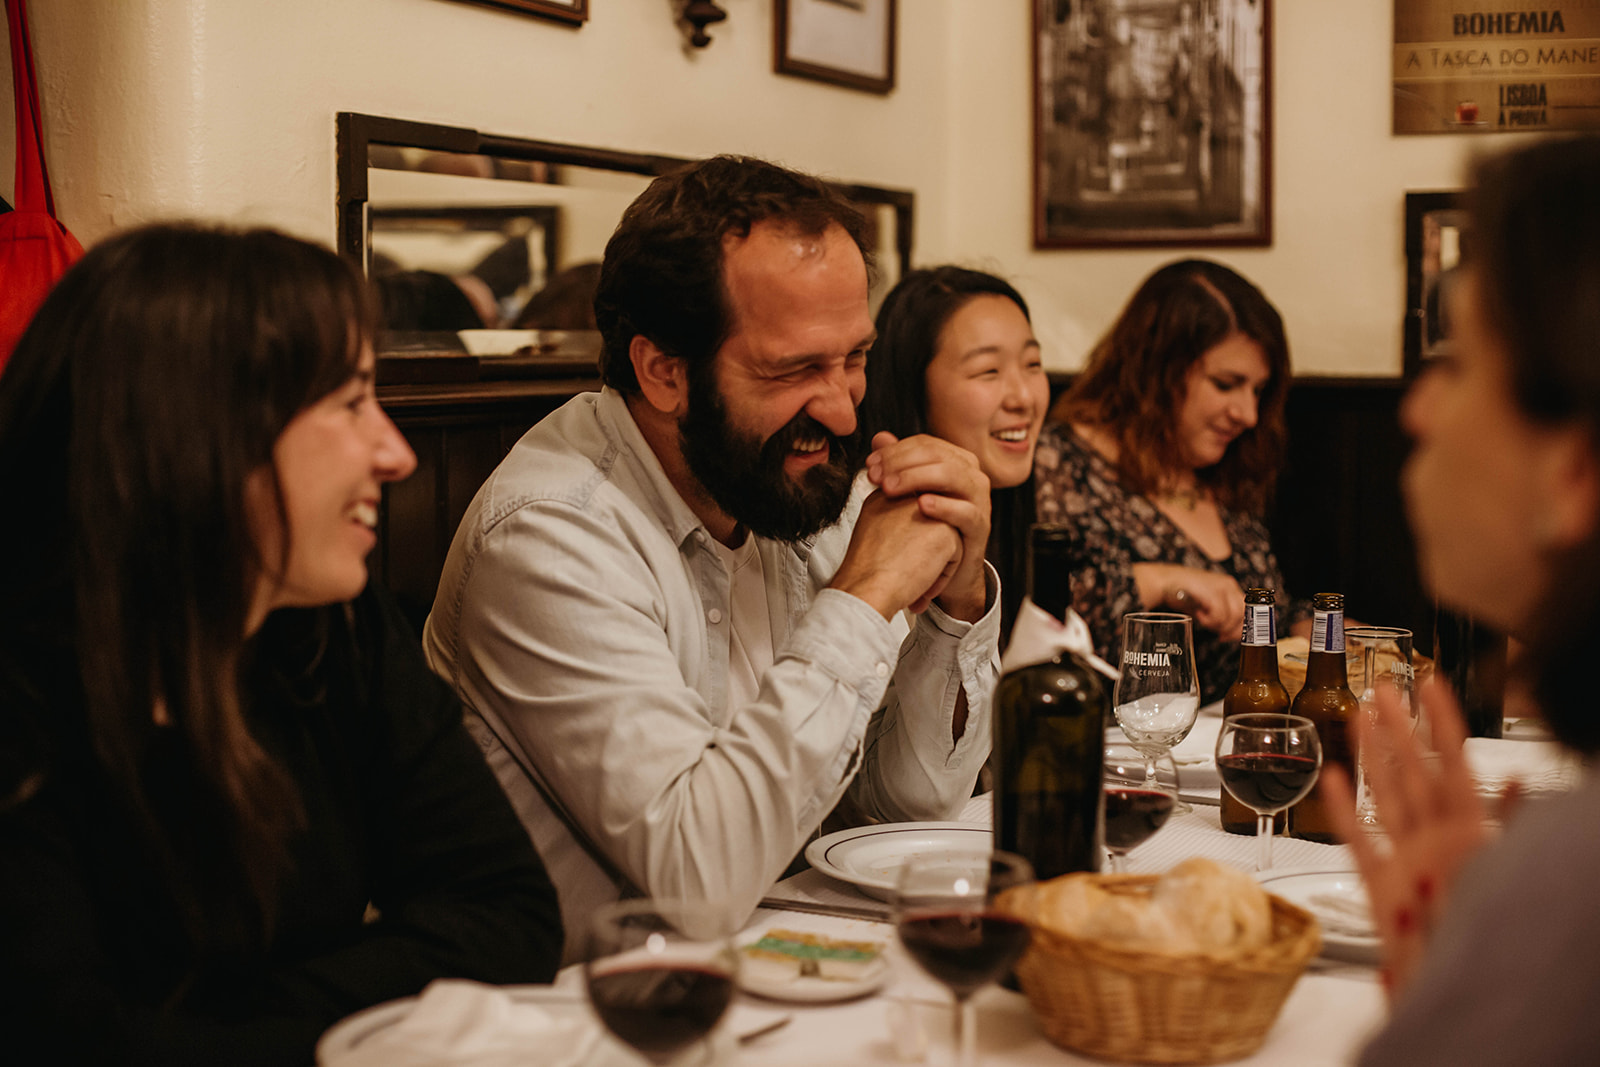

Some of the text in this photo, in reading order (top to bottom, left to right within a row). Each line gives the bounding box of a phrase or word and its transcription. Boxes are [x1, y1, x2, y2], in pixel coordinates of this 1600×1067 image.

[1453, 10, 1565, 35] BOHEMIA
[1405, 47, 1599, 69] A TASCA DO MANE
[1499, 83, 1547, 107] LISBOA
[1124, 650, 1171, 667] BOHEMIA
[1138, 669, 1170, 677] CERVEJA
